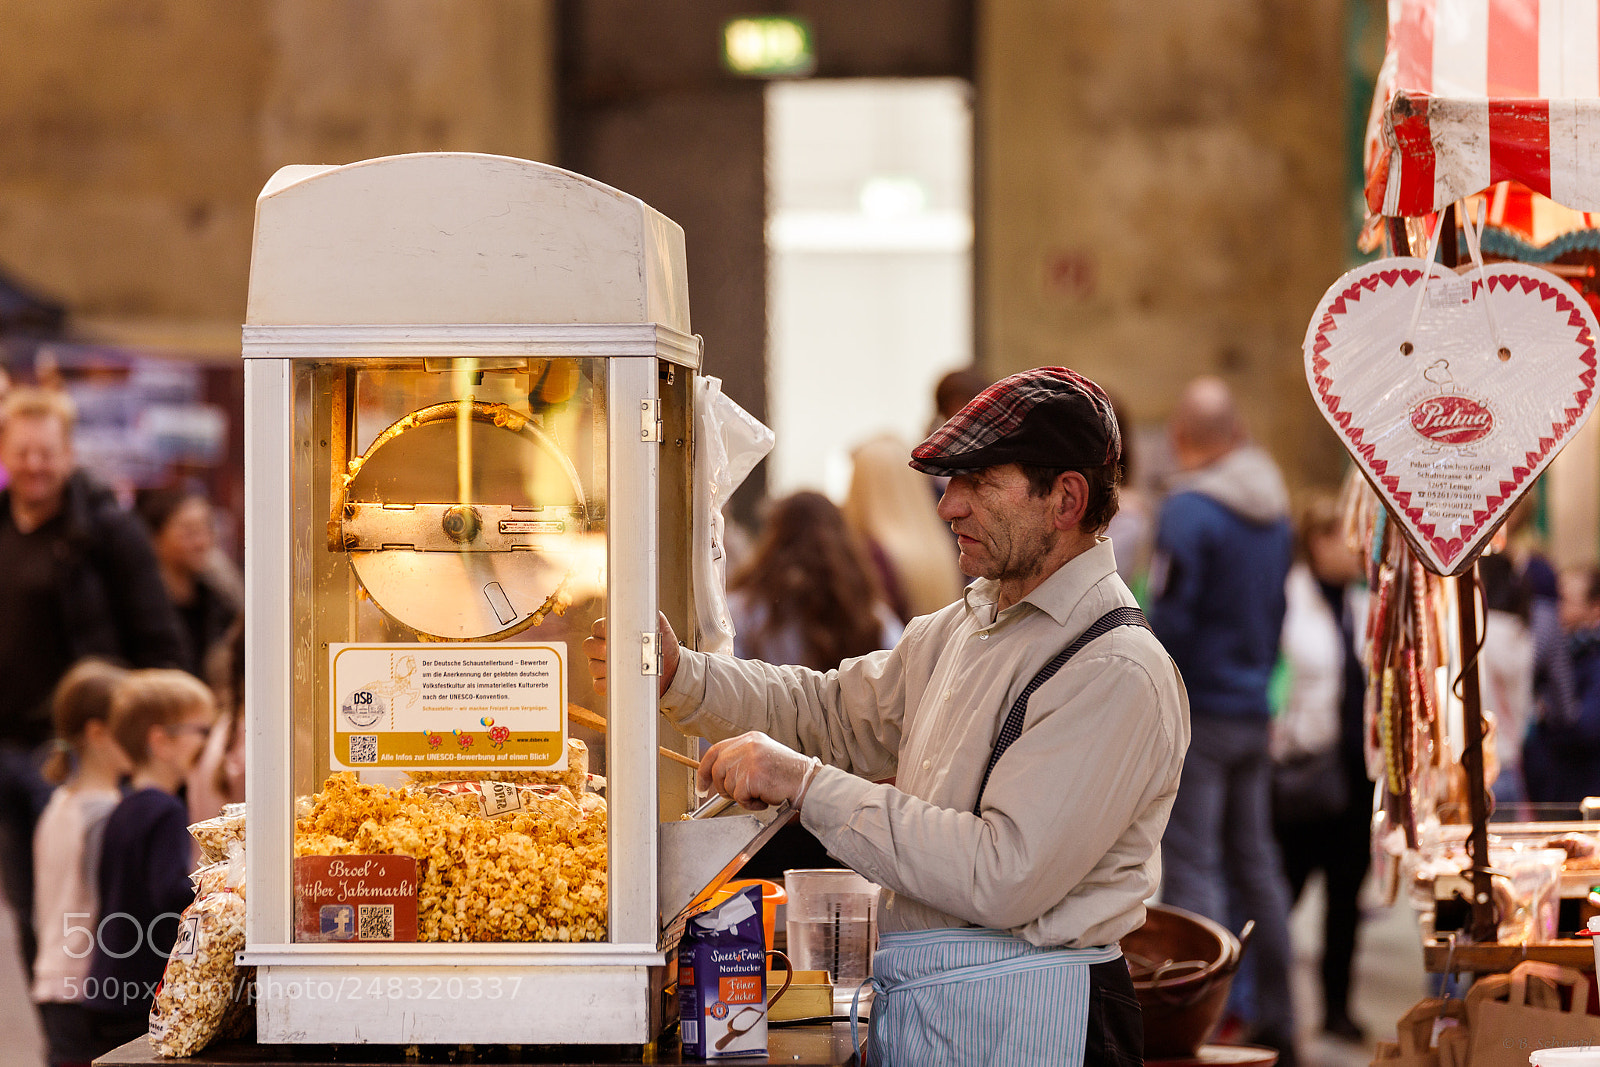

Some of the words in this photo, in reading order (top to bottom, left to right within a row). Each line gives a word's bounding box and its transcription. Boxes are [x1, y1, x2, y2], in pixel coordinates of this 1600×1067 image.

[1416, 403, 1489, 430] Pahna
[1469, 464, 1491, 472] GmbH
[1449, 483, 1472, 491] Lemgo
[354, 692, 373, 705] DSB
[426, 754, 495, 762] UNESCO-Bewerbung
[299, 880, 335, 903] süßer
[337, 879, 415, 902] Jahrmarkt
[711, 950, 737, 962] Sweet
[739, 949, 765, 963] Family
[720, 964, 761, 973] Nordzucker
[727, 978, 756, 990] Feiner
[727, 991, 756, 1001] Zucker
